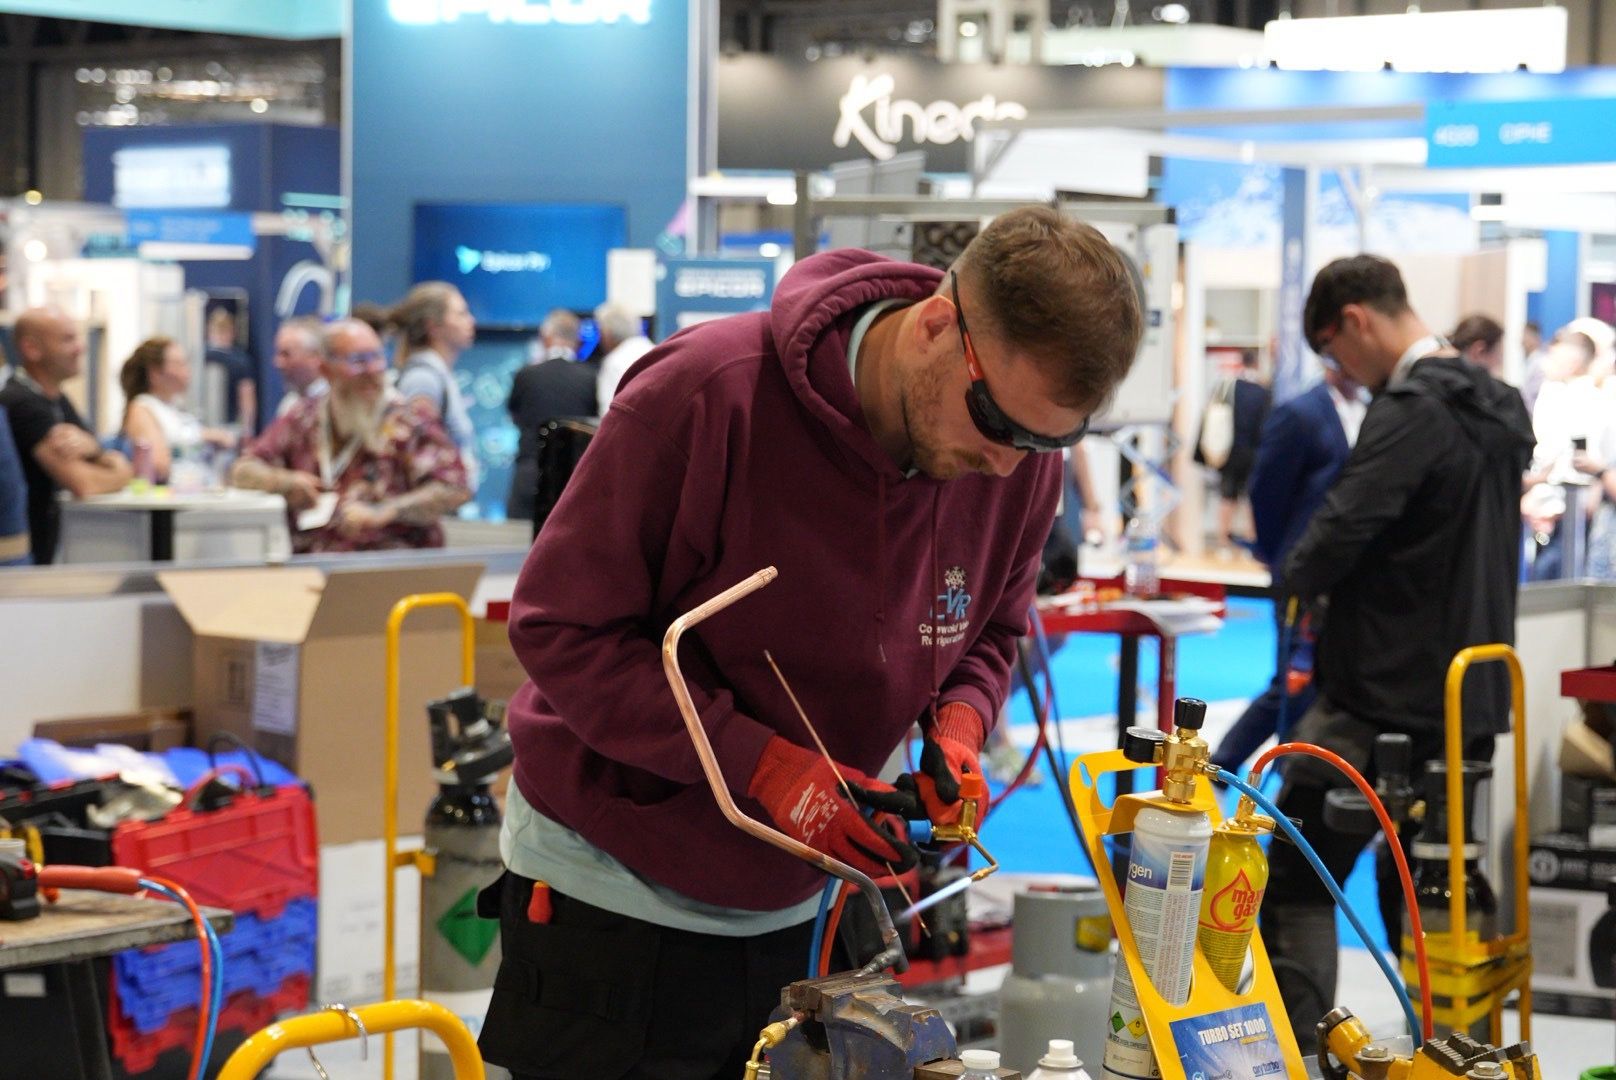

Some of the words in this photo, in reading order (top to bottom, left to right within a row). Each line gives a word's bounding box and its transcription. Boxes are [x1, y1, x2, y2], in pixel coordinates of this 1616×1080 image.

[1198, 1026, 1228, 1046] TURBO
[1227, 1022, 1245, 1040] SET
[1243, 1017, 1267, 1036] 1000
